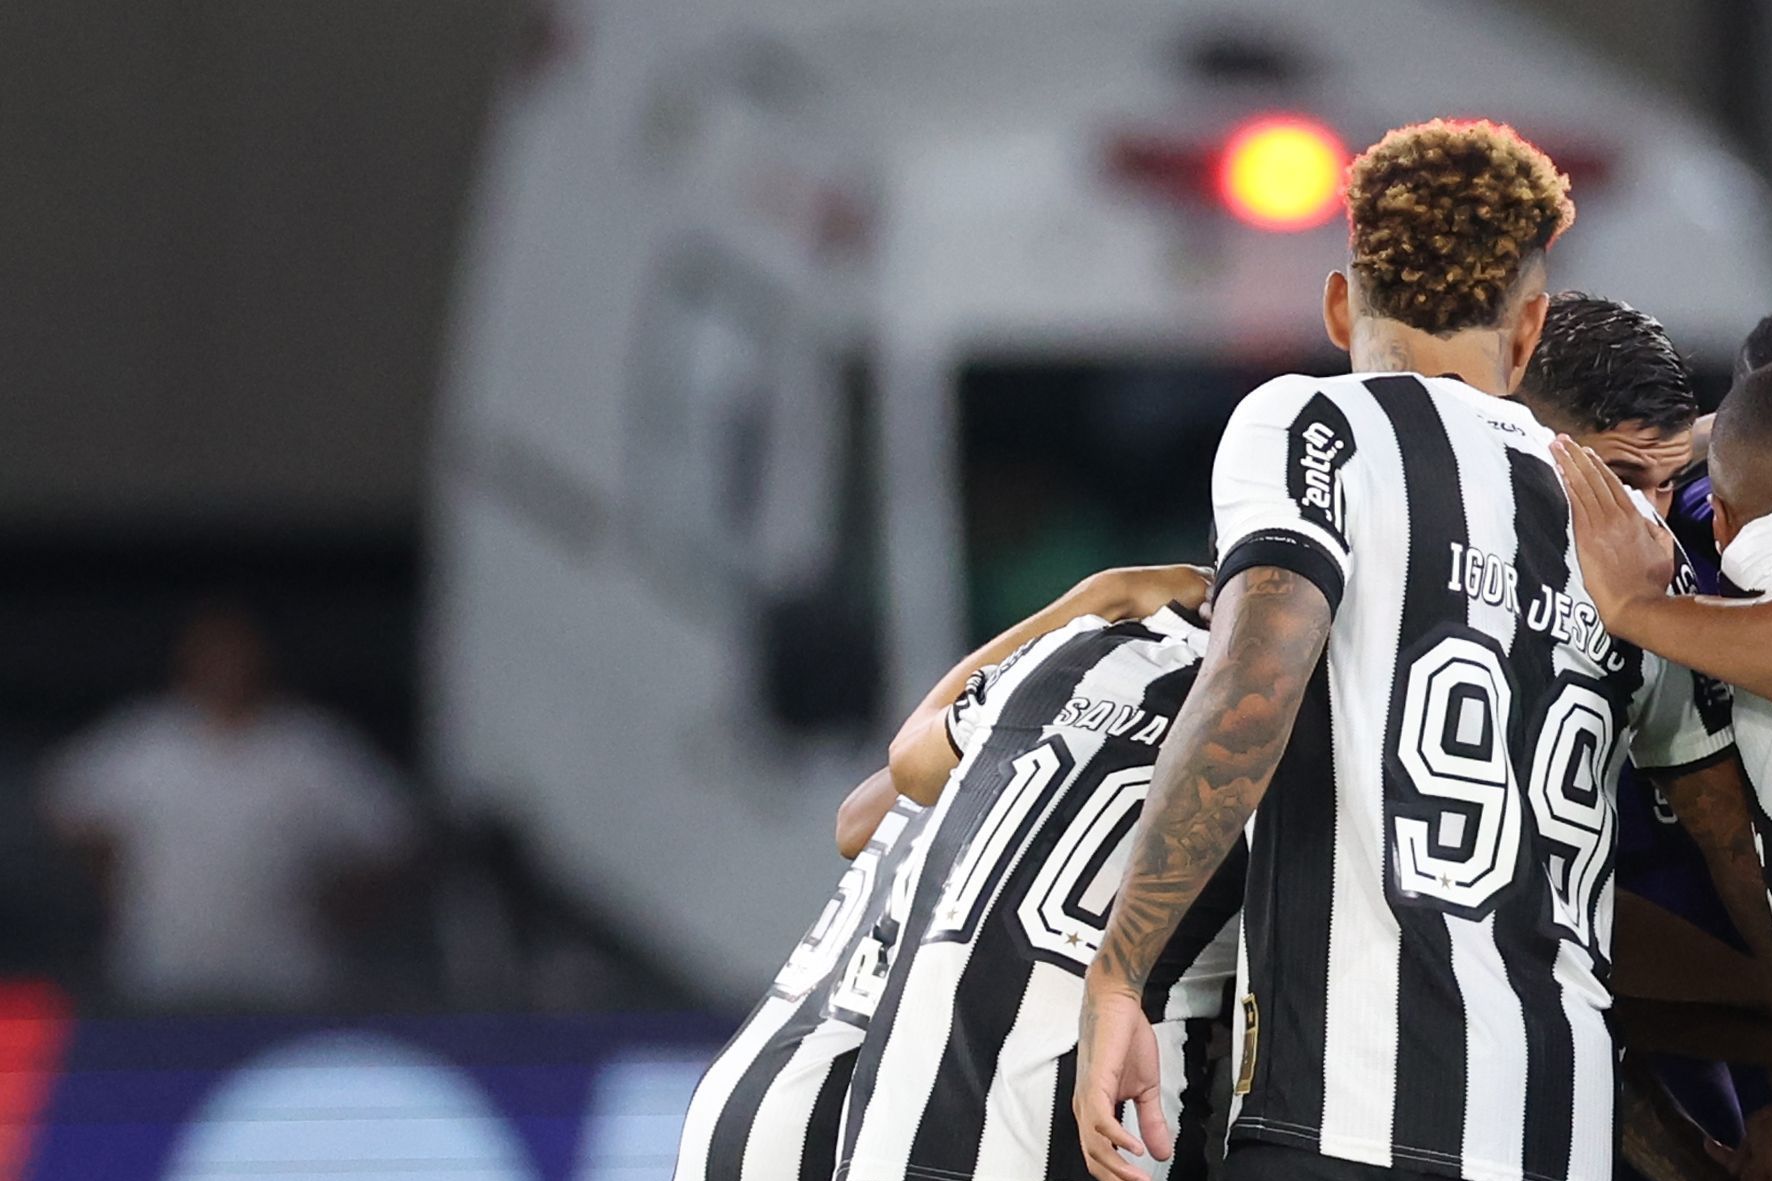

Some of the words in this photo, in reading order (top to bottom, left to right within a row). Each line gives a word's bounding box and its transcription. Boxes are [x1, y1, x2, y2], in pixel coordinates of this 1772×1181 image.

[1447, 542, 1522, 615] IGOR
[1051, 696, 1171, 746] SAVA
[1395, 634, 1615, 948] 99
